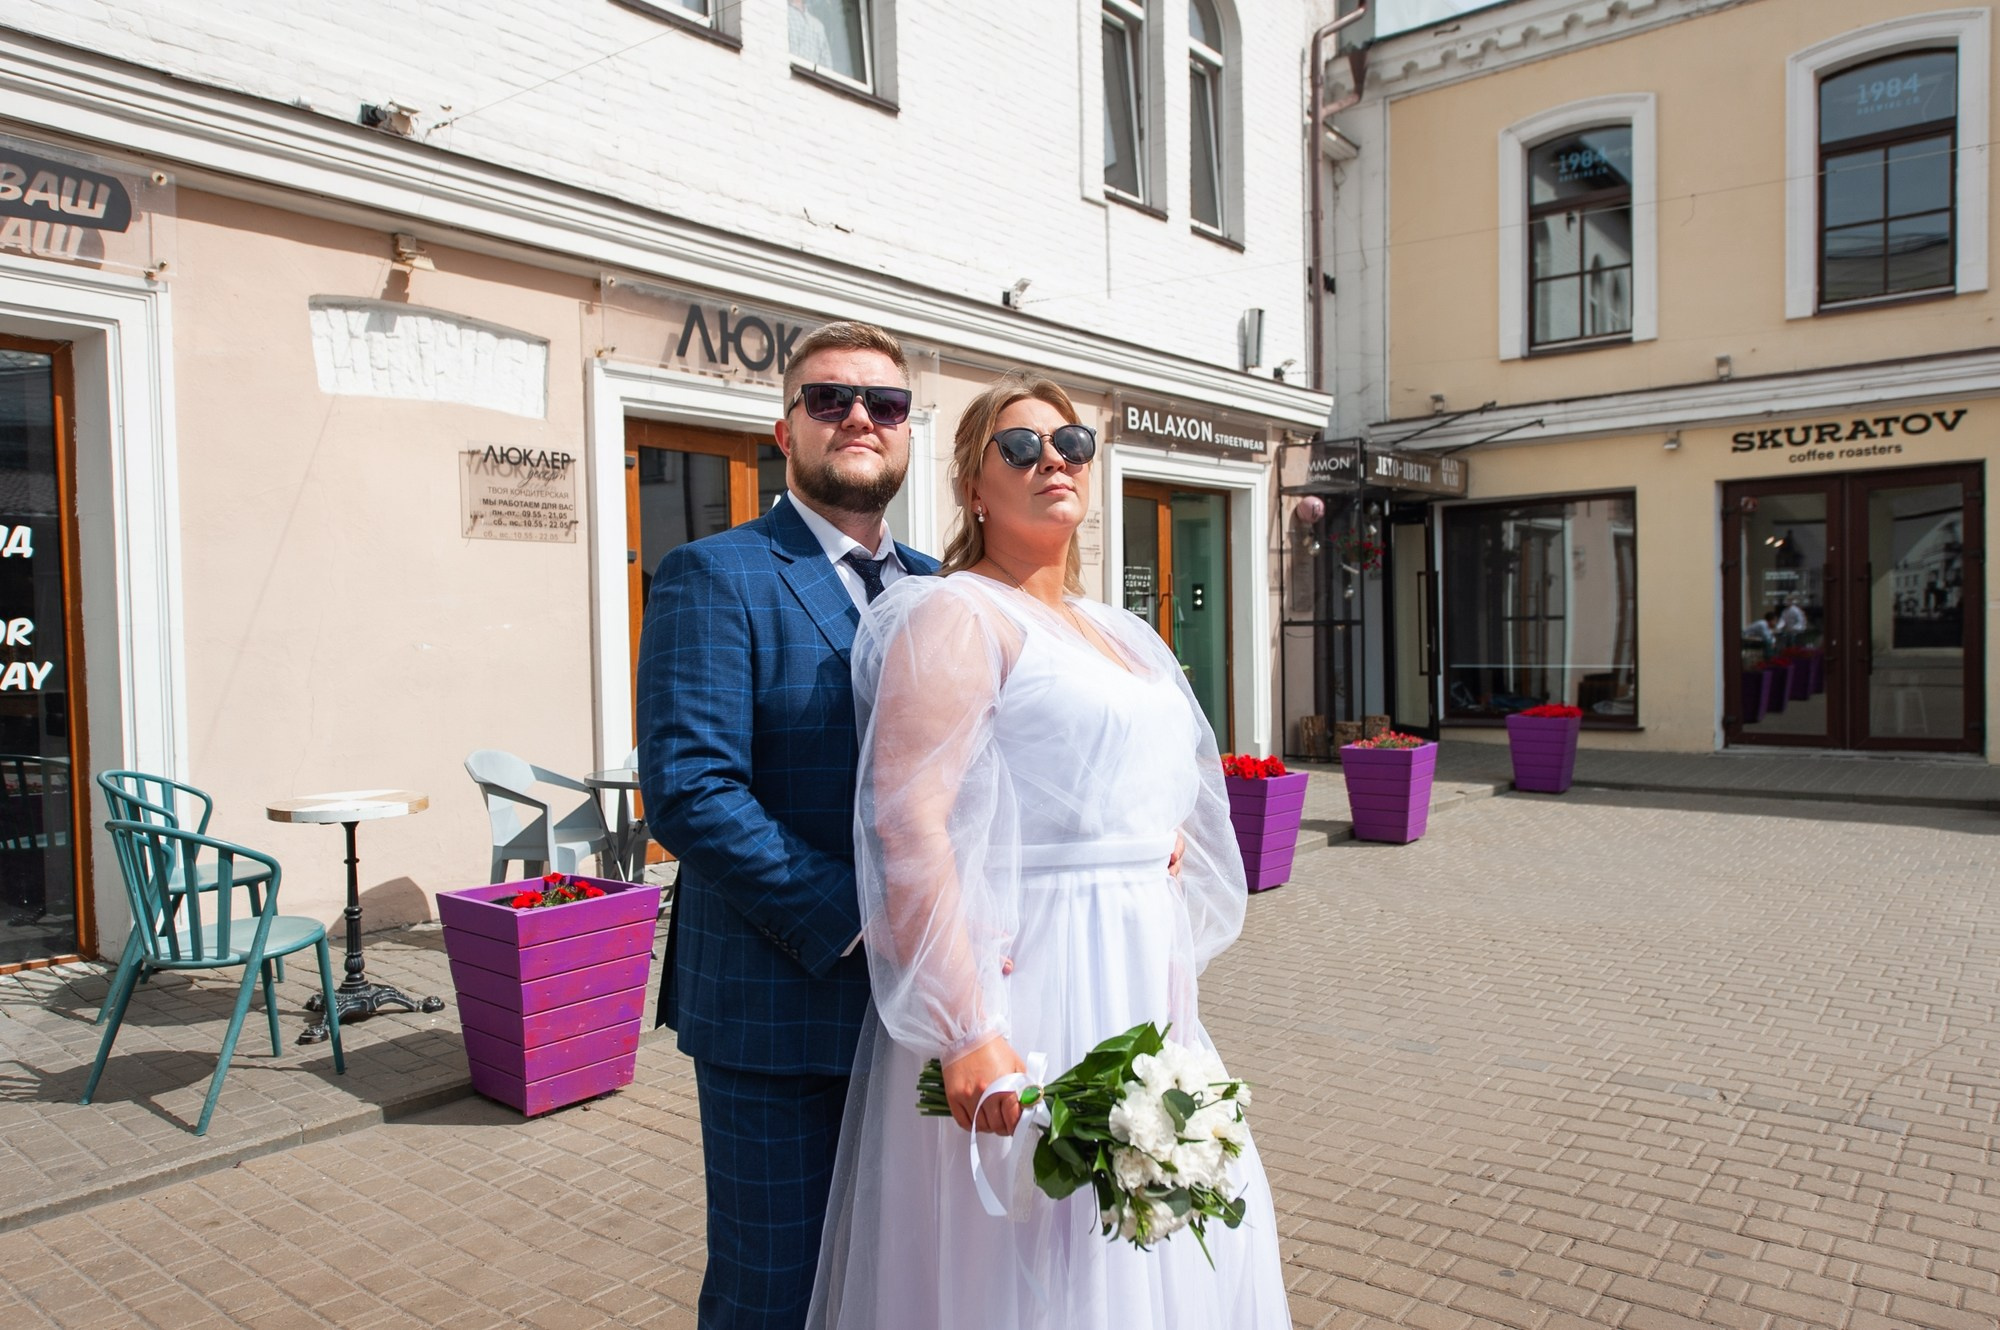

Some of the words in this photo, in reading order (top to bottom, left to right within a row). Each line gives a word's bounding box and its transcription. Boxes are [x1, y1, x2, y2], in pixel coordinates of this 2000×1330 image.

[1857, 72, 1919, 105] 1984
[1559, 147, 1608, 173] 1984
[1127, 406, 1213, 443] BALAXON
[1214, 433, 1265, 451] STREETWEAR
[1732, 409, 1968, 453] SKURATOV
[483, 444, 571, 471] ЛЮКЛЕР
[1788, 448, 1835, 464] coffee
[1839, 443, 1903, 459] roasters
[482, 498, 496, 506] МЫ
[498, 499, 540, 509] РАБОТАЕМ
[488, 486, 508, 495] ТВОЯ
[510, 488, 569, 500] КОНДИТЕРСКАЯ
[523, 519, 543, 528] 10.55
[549, 520, 569, 529] 22.05
[548, 512, 568, 520] 21.05
[0, 661, 54, 691] AY
